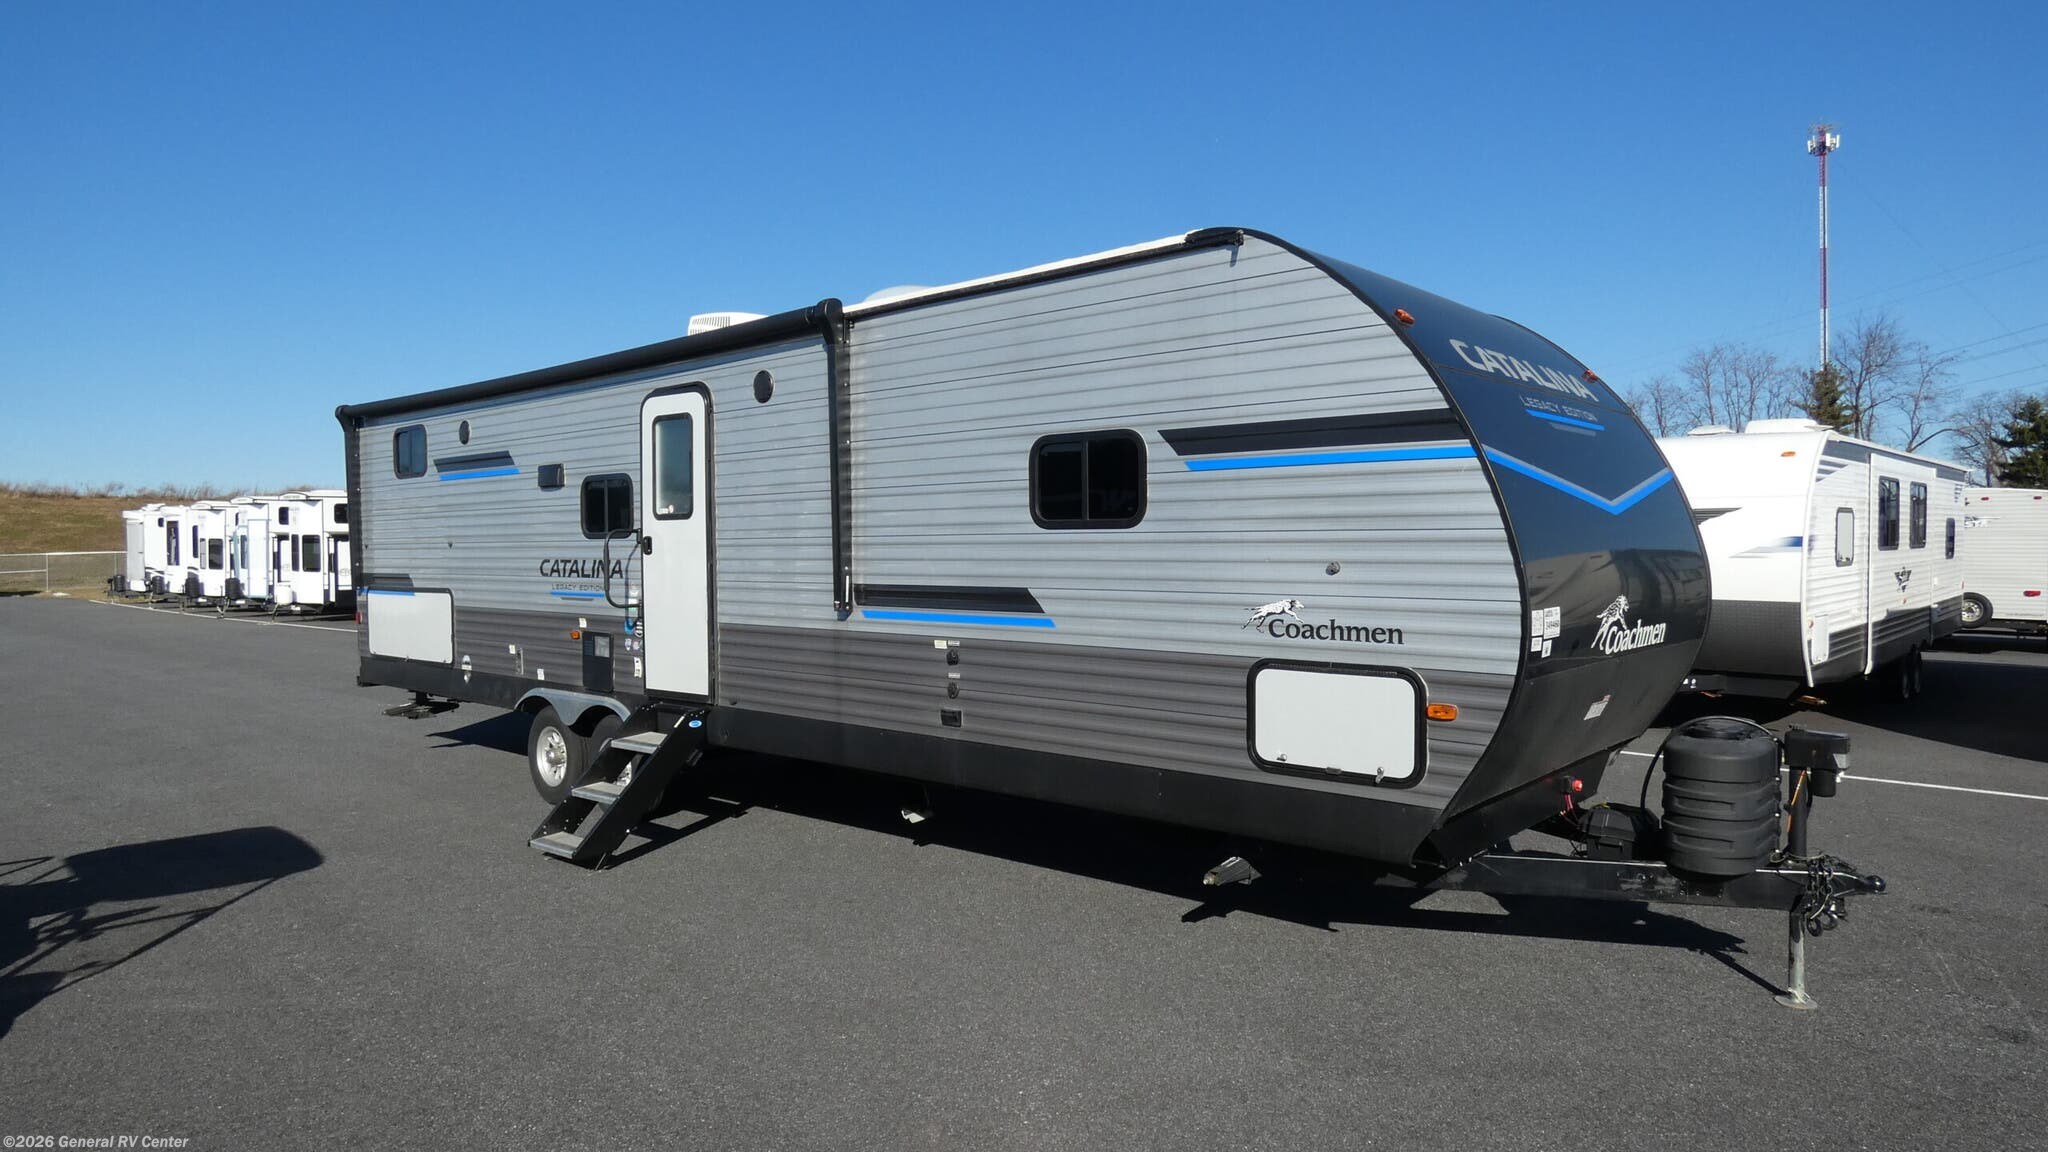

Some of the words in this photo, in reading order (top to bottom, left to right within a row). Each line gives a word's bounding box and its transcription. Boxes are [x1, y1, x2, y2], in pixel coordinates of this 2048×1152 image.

[1450, 339, 1599, 402] CATALINA
[1520, 395, 1561, 413] LEGACY
[551, 583, 577, 591] LEGACY
[1268, 617, 1405, 645] Coachmen
[1605, 619, 1667, 655] Coachmen
